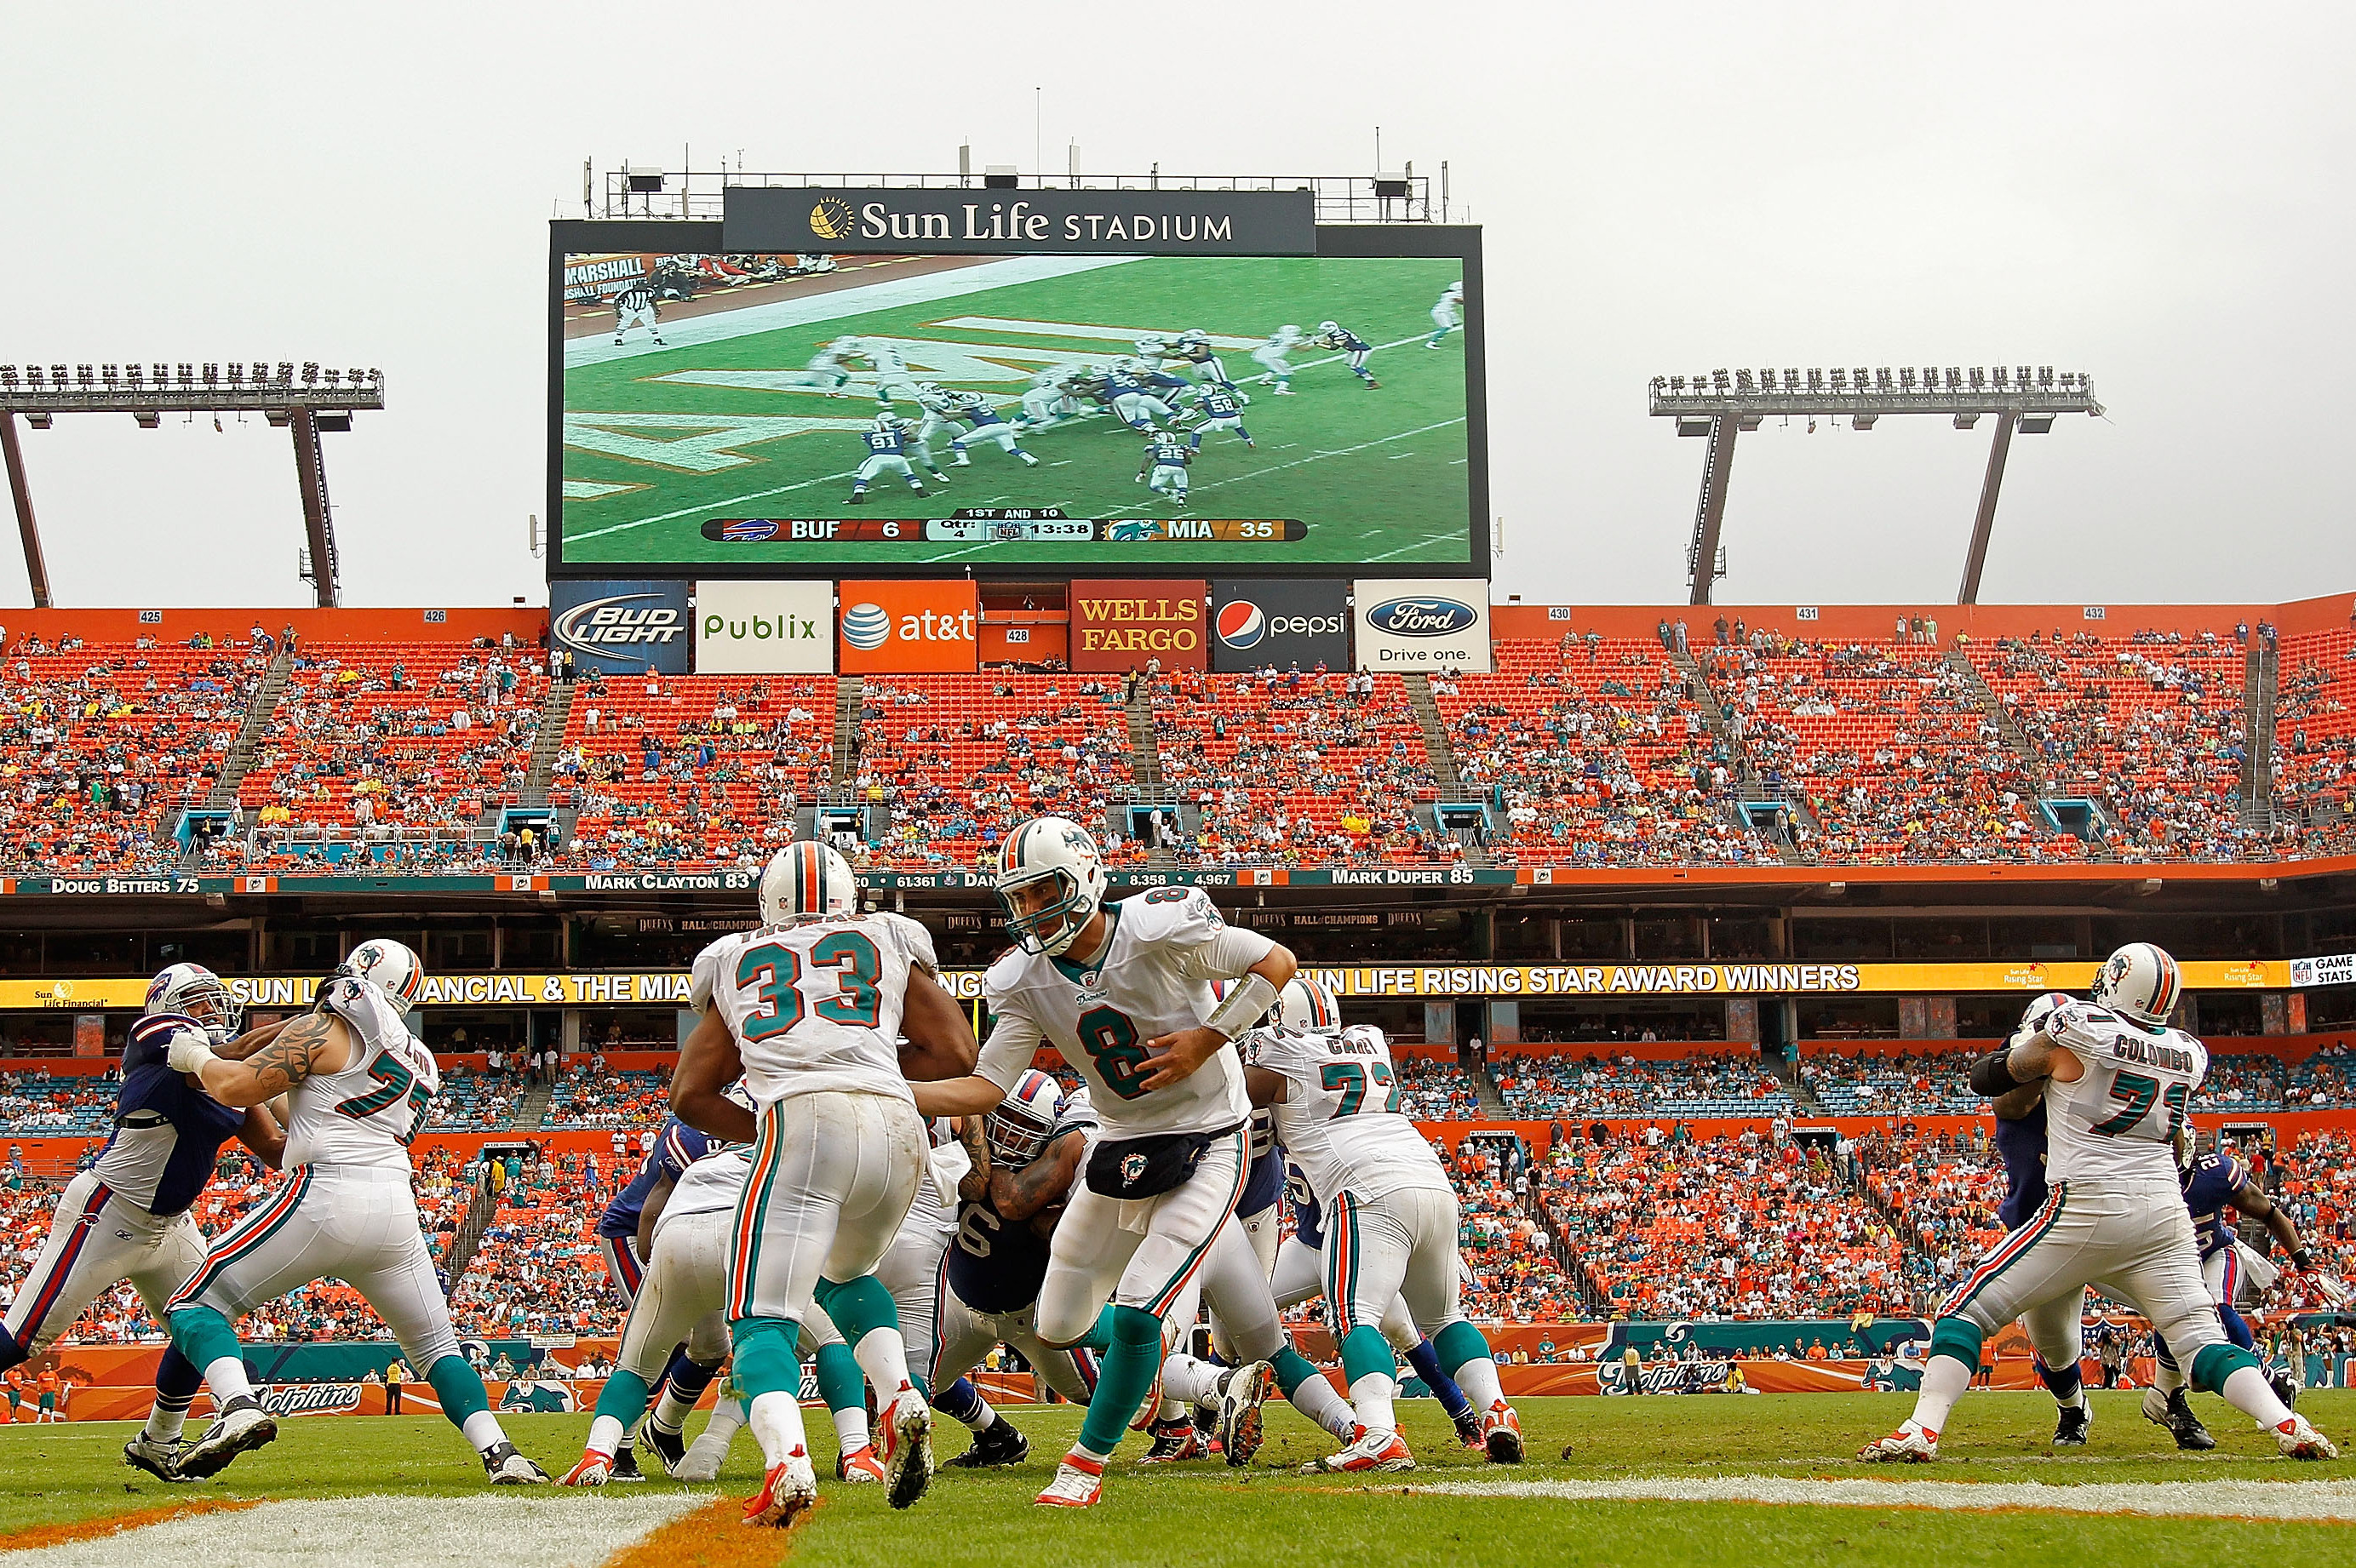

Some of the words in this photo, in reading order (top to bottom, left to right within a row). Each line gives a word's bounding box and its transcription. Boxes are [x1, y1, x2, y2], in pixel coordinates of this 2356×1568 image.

[861, 203, 952, 240] Sun
[961, 201, 1050, 240] Life
[1063, 214, 1233, 241] STADIUM
[565, 257, 645, 286] MARSHALL
[1210, 398, 1235, 413] 58
[869, 435, 898, 450] 91
[966, 508, 996, 518] 1ST
[1003, 509, 1032, 518] AND
[1040, 508, 1059, 518] 10
[790, 520, 841, 540] BUF
[882, 521, 900, 538] 6
[940, 519, 976, 529] Qtr:
[1031, 524, 1090, 535] 13:38
[1167, 520, 1213, 539] MIA
[1240, 522, 1273, 538] 35
[953, 529, 966, 539] 4
[140, 611, 161, 622] 425
[425, 611, 446, 622] 426
[590, 608, 679, 627] BUD
[1077, 598, 1199, 622] WELLS
[1388, 603, 1455, 632] Ford
[1550, 608, 1569, 620] 430
[1798, 608, 1818, 619] 431
[2085, 607, 2105, 619] 432
[704, 614, 817, 640] Publix
[898, 612, 975, 641] at&t
[1270, 611, 1345, 638] pepsi
[570, 626, 685, 644] LIGHT
[1008, 629, 1028, 643] 428
[1081, 627, 1199, 651] FARGO
[1379, 648, 1439, 661] Drive
[1444, 650, 1471, 661] one.
[584, 875, 638, 890] MARK
[641, 874, 719, 890] CLAYTON
[725, 873, 750, 889] 83
[1129, 875, 1167, 887] 8,358
[1194, 874, 1231, 886] 4,967
[1332, 870, 1383, 884] MARK
[1387, 870, 1443, 884] DUPER
[1449, 869, 1475, 884] 85
[51, 878, 101, 893] DOUG
[106, 878, 170, 893] BETTERS
[175, 878, 199, 893] 75
[712, 919, 764, 930] CHAMPION
[2315, 955, 2353, 970] GAME
[2003, 975, 2026, 984] Rising
[2224, 973, 2246, 982] Rising
[2294, 970, 2311, 980] NFL
[2318, 970, 2353, 983] STATS
[231, 978, 295, 1004] SUN
[542, 976, 566, 1002] &
[570, 976, 632, 1001] THE
[1354, 969, 1416, 993] LIFE
[1423, 968, 1522, 993] RISING
[1528, 967, 1605, 993] STAR
[1609, 966, 1717, 992] AWARD
[1723, 964, 1860, 991] WINNERS
[736, 930, 883, 1044] 33
[33, 990, 53, 999] Sun
[1075, 1004, 1161, 1101] 8
[2112, 1033, 2193, 1073] COLOMBO
[2089, 1069, 2190, 1142] 71
